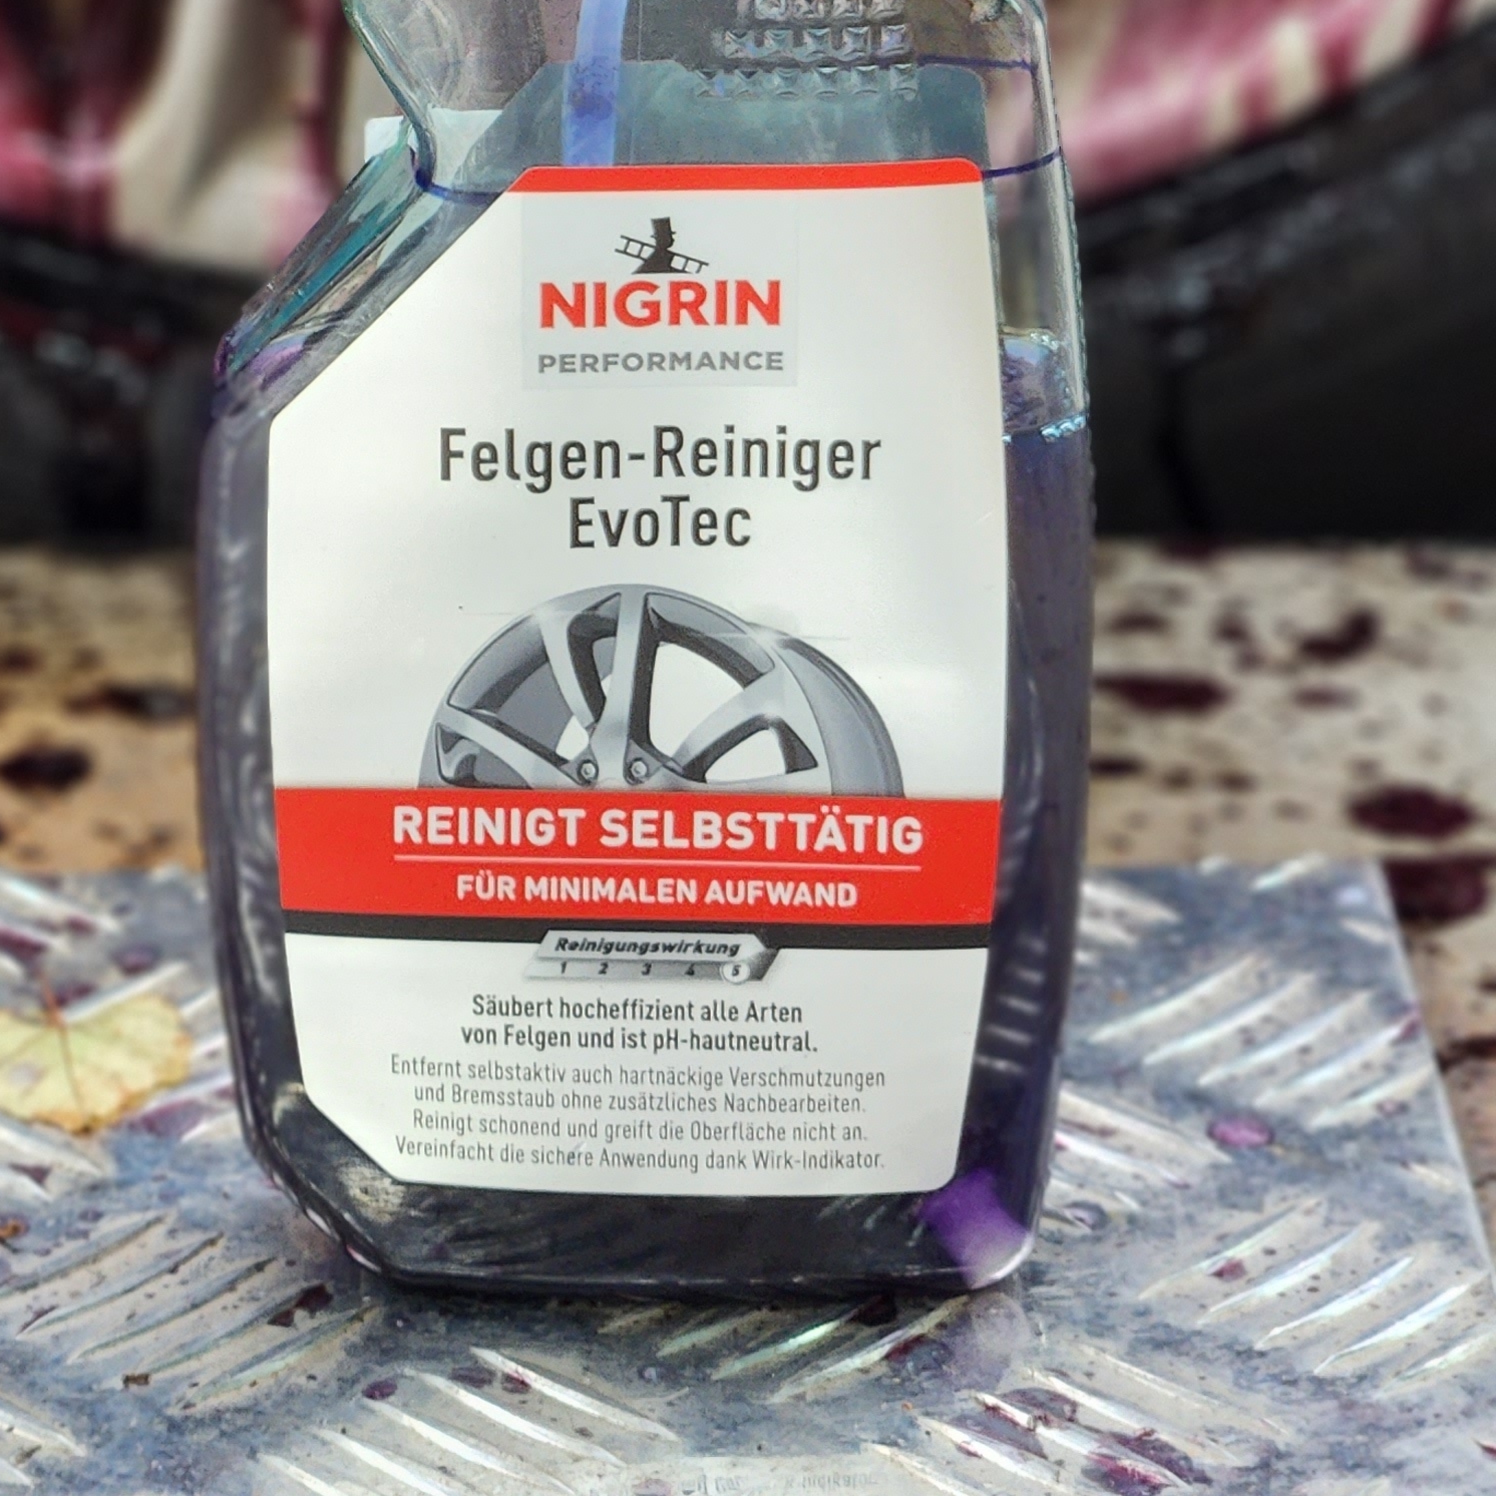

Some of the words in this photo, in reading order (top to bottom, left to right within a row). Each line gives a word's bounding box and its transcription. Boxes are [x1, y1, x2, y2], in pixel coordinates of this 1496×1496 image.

[539, 280, 781, 329] NIGRIN
[538, 349, 784, 374] PERFORMANCE
[440, 425, 881, 493] Felgen-Reiniger
[569, 495, 752, 548] EvoTec
[393, 805, 586, 846] REINIGT
[601, 805, 924, 853] SELBSTTÄTIG
[456, 870, 516, 900] FÜR
[525, 877, 697, 904] MINIMALEN
[705, 881, 858, 907] AUFWAND
[555, 938, 741, 957] Reinigungswirkung
[560, 963, 567, 973] 1
[598, 964, 608, 974] 2
[641, 964, 652, 975] 3
[685, 964, 695, 976] 4
[731, 964, 741, 976] 5
[472, 994, 553, 1018] Säubert
[560, 997, 695, 1021] hocheffizient
[701, 1000, 739, 1021] alle
[745, 1001, 802, 1023] Arten
[461, 1026, 497, 1045] von
[504, 1024, 570, 1051] Felgen
[578, 1027, 614, 1048] und
[621, 1027, 647, 1049] ist
[654, 1028, 818, 1055] pH-hautneutral.
[391, 1054, 461, 1078] Entfernt
[468, 1060, 566, 1082] selbstaktiv
[572, 1065, 612, 1084] auch
[620, 1065, 723, 1091] hartnäckige
[730, 1067, 885, 1092] Verschmutzungen
[415, 1083, 444, 1102] und
[452, 1084, 554, 1108] Bremsstaub
[561, 1090, 602, 1109] ohne
[609, 1094, 717, 1113] zusätzliches
[724, 1093, 866, 1113] Nachbearbeiten.
[414, 1109, 473, 1136] Reinigt
[479, 1115, 560, 1136] schonend
[568, 1119, 597, 1138] und
[605, 1120, 652, 1143] greift
[660, 1121, 684, 1140] die
[691, 1121, 785, 1141] Oberfläche
[793, 1123, 836, 1141] nicht
[843, 1126, 867, 1141] an.
[396, 1135, 494, 1160] Vereinfacht
[500, 1145, 524, 1164] die
[531, 1145, 593, 1166] sichere
[599, 1148, 699, 1173] Anwendung
[706, 1151, 746, 1169] dank
[753, 1151, 884, 1170] Wirk-Indikator.
